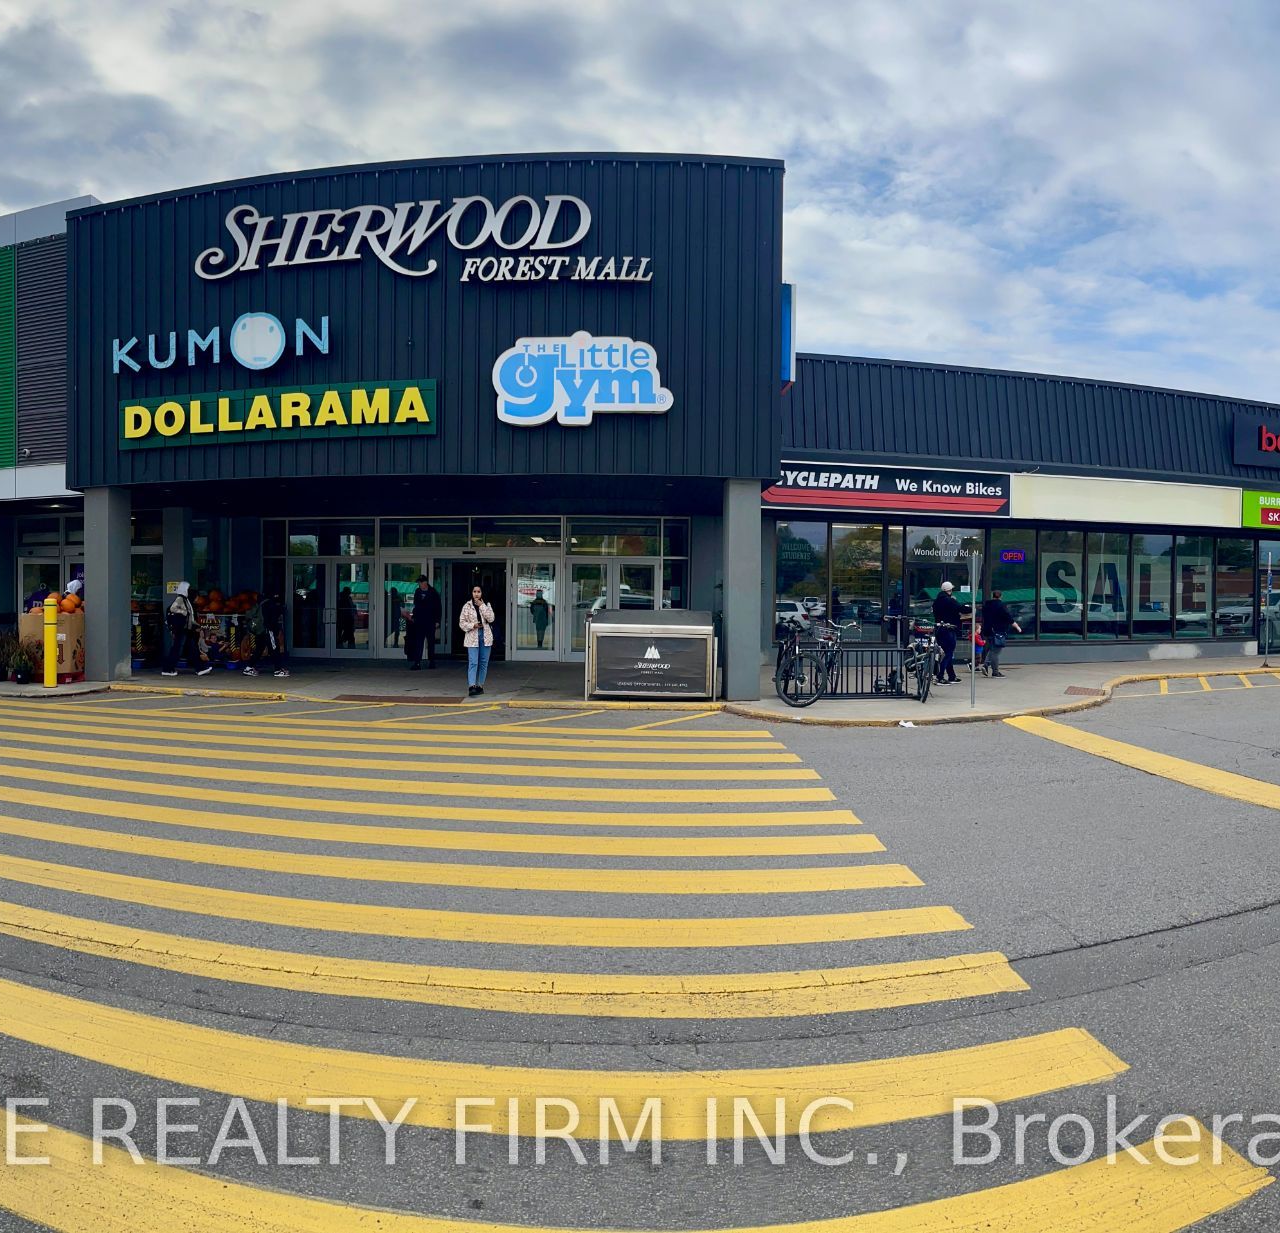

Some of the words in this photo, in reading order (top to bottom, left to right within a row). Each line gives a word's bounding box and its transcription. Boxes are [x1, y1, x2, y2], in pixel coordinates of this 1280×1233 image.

[194, 194, 592, 280] SHERWOOD
[459, 255, 569, 283] FOREST
[571, 256, 654, 282] MALL
[112, 311, 329, 374] KUMON
[523, 343, 560, 353] THE
[560, 341, 650, 368] Little
[499, 353, 656, 418] gym
[124, 386, 430, 439] DOLLARAMA
[895, 478, 918, 492] We
[922, 480, 962, 494] Know
[965, 482, 1002, 496] Bikes
[913, 548, 958, 557] Wonderland
[960, 549, 971, 557] Rd.
[935, 534, 962, 545] 1225
[1002, 552, 1024, 561] OPEN
[1045, 560, 1207, 614] SALE
